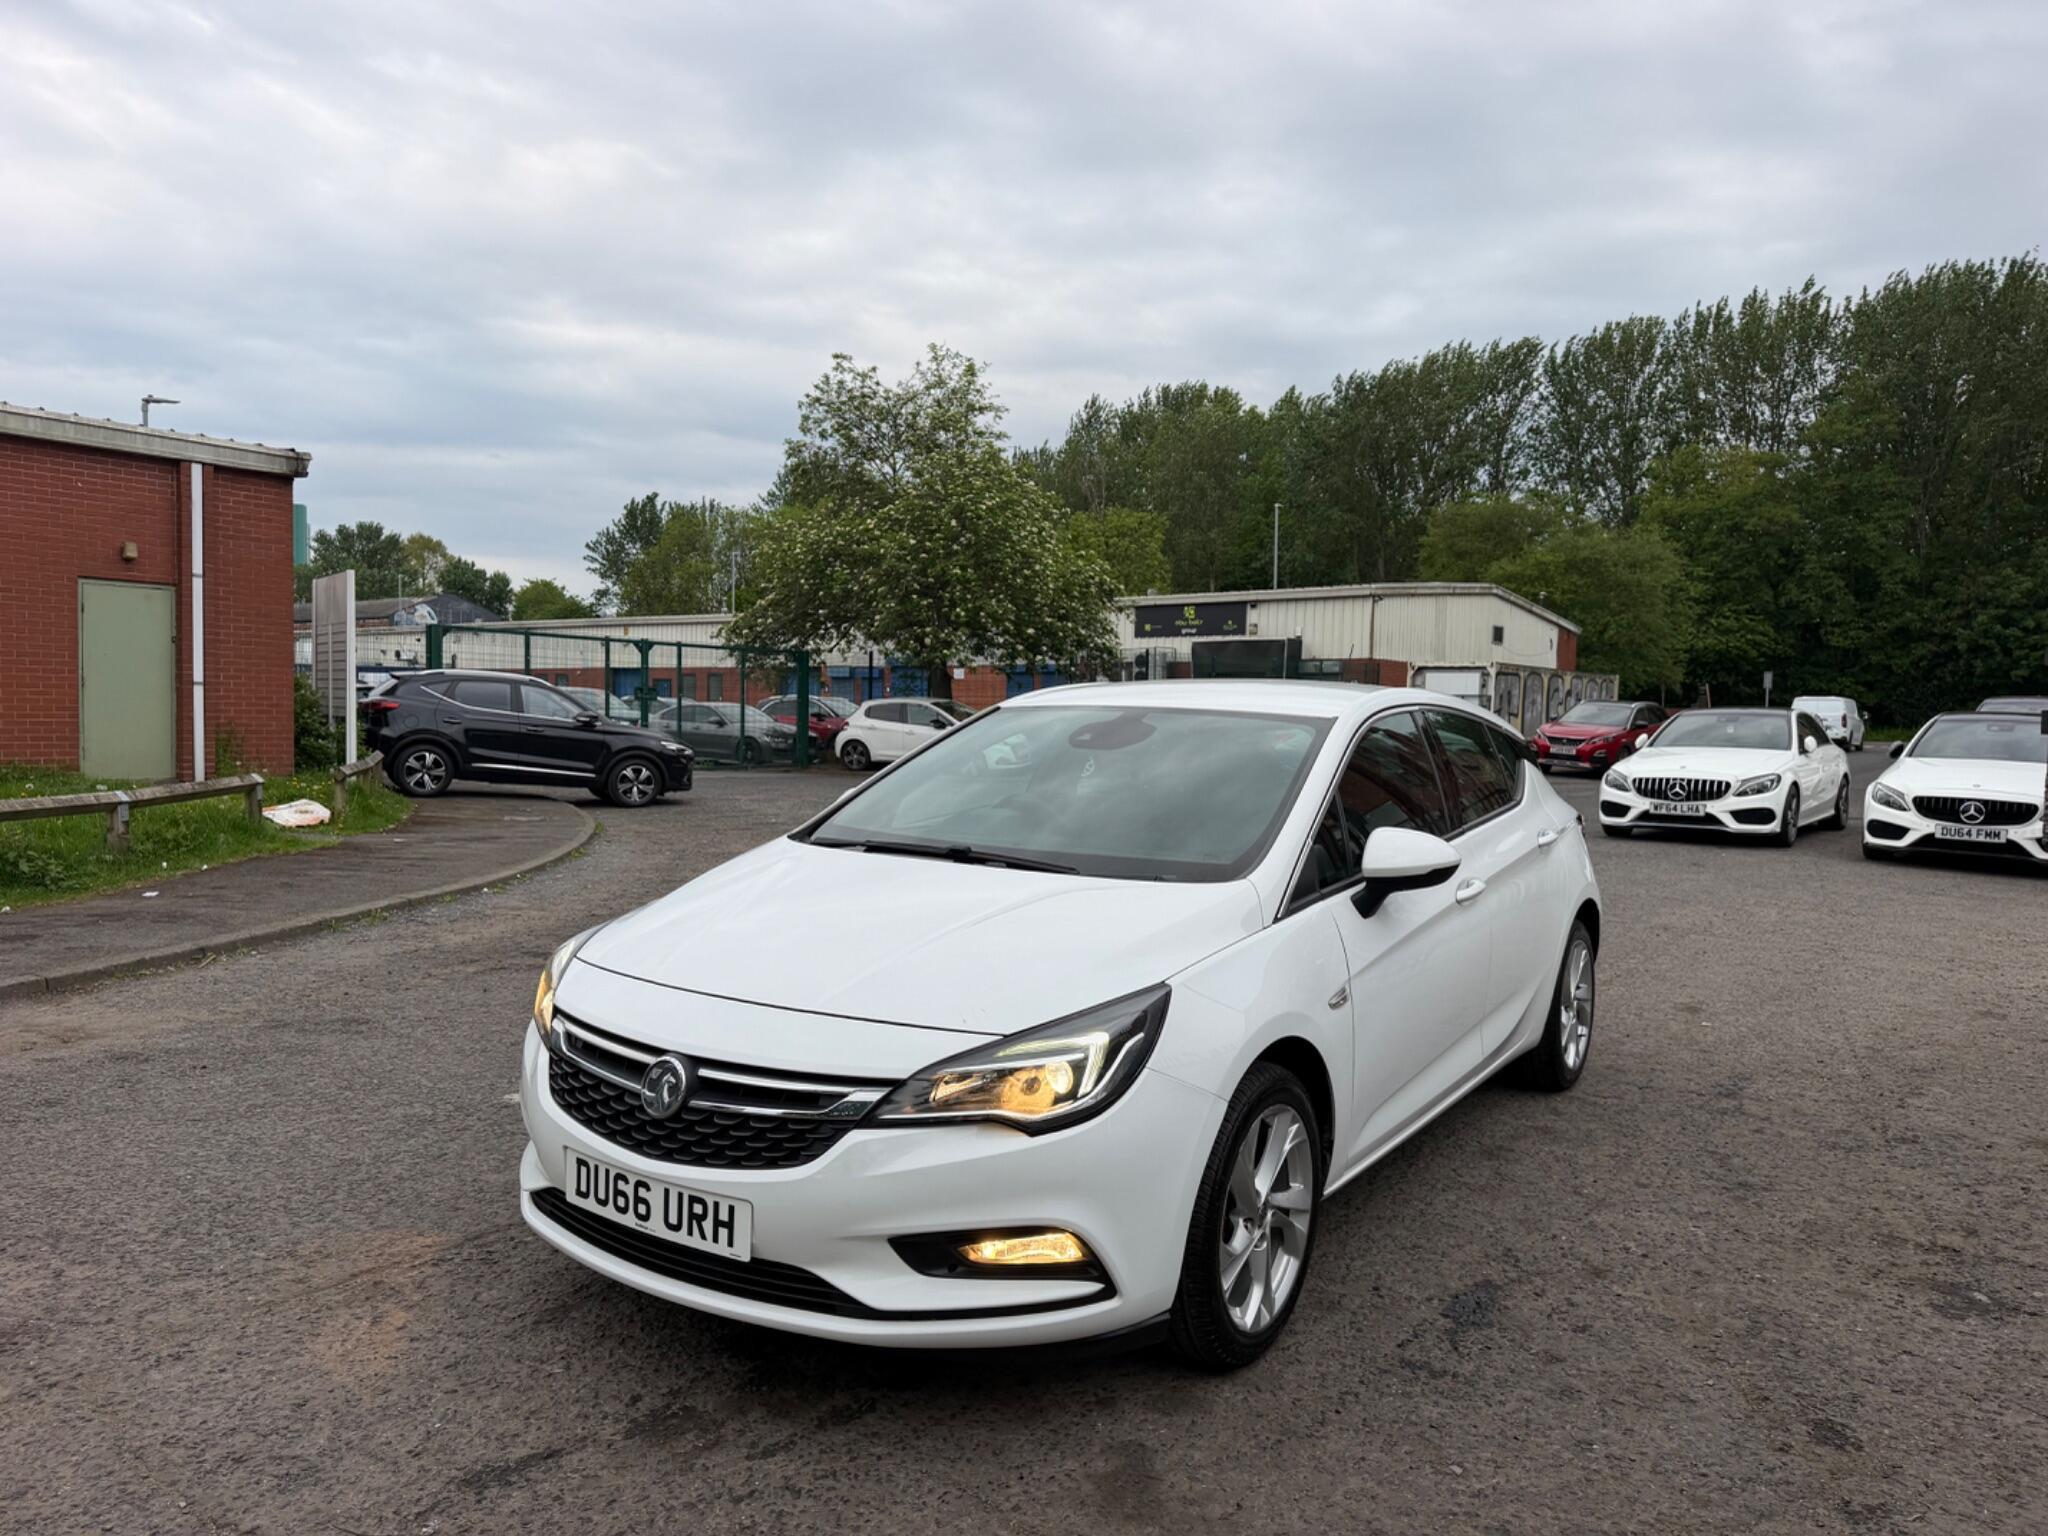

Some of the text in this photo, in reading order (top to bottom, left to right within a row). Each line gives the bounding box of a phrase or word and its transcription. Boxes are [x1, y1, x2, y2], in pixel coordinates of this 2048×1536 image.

[1941, 826, 2001, 841] DU64 FMM
[575, 1157, 735, 1248] DU66 URH
